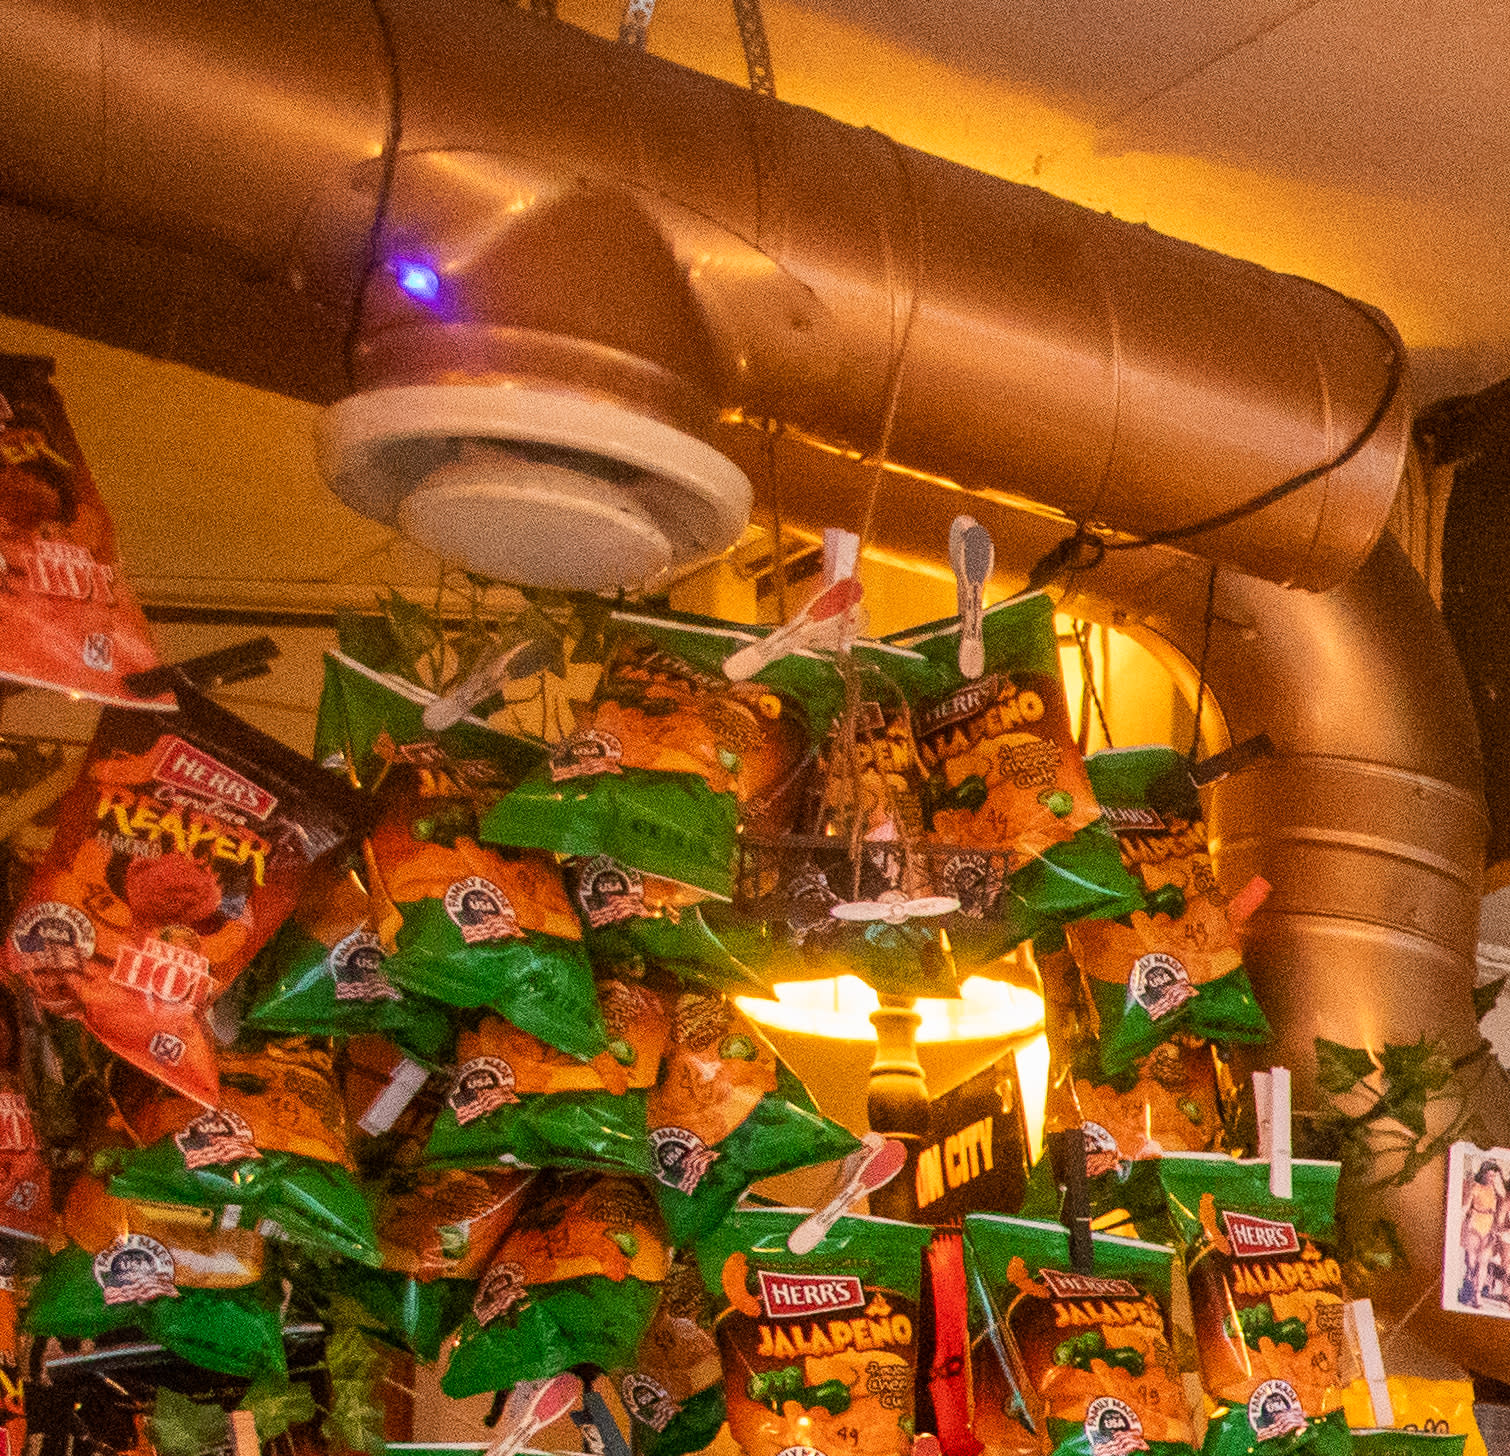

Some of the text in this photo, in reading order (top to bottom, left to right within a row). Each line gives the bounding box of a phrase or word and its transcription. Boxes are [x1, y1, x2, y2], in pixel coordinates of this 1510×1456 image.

[945, 1117, 993, 1188] CITY
[1235, 1224, 1289, 1247] HERR'S
[771, 1280, 851, 1306] HERR'S
